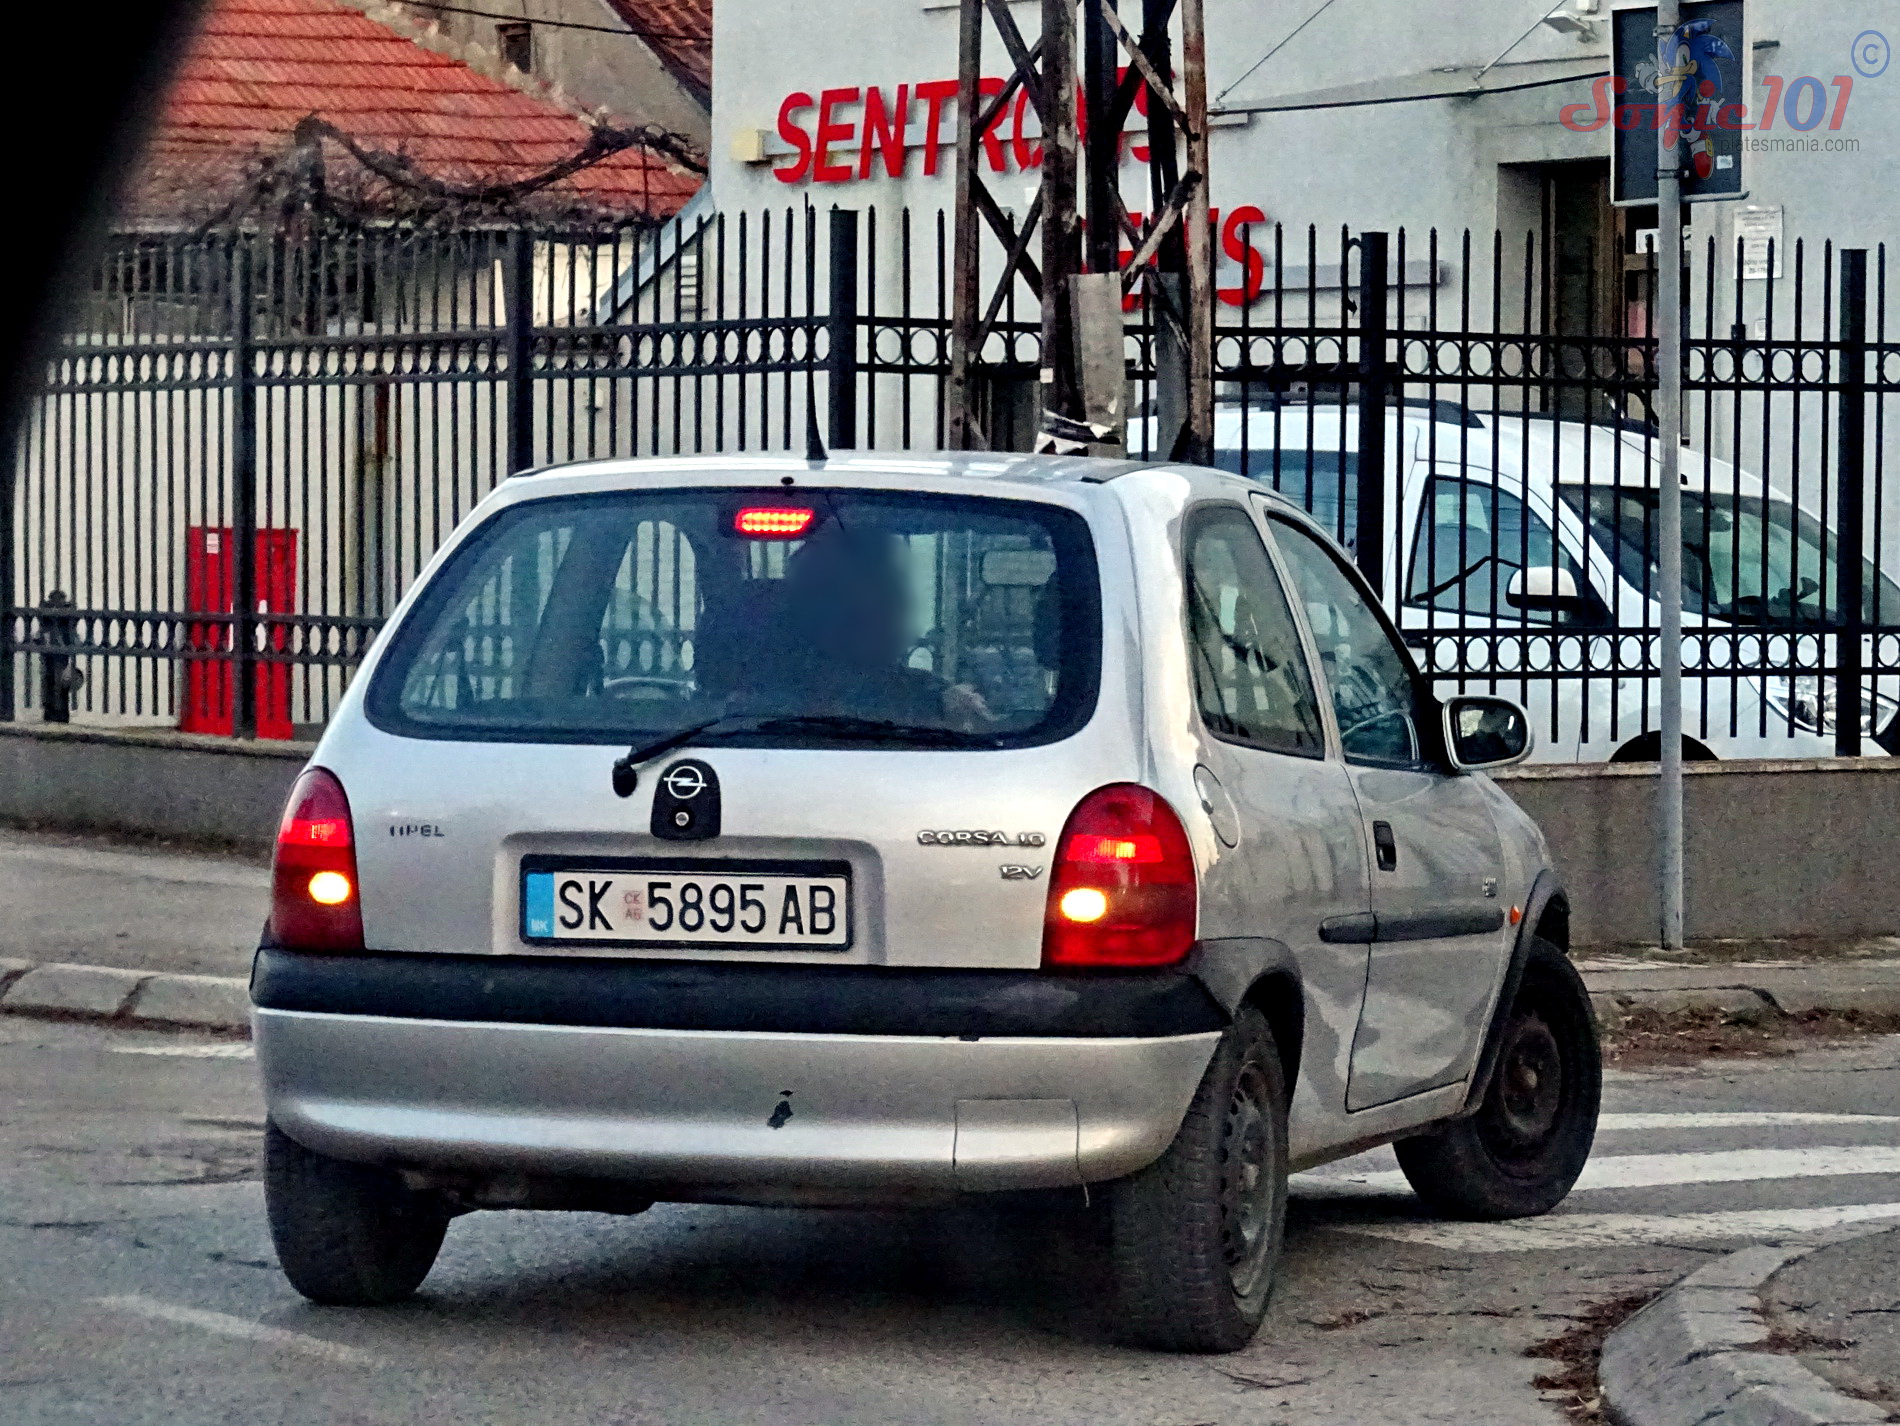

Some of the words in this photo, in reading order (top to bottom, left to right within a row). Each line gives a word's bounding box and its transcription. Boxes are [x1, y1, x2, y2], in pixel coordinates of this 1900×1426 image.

[917, 829, 1007, 846] CORSA
[1000, 864, 1043, 880] 12V
[559, 880, 614, 930] SK
[648, 882, 766, 933] 5895
[779, 885, 836, 936] AB
